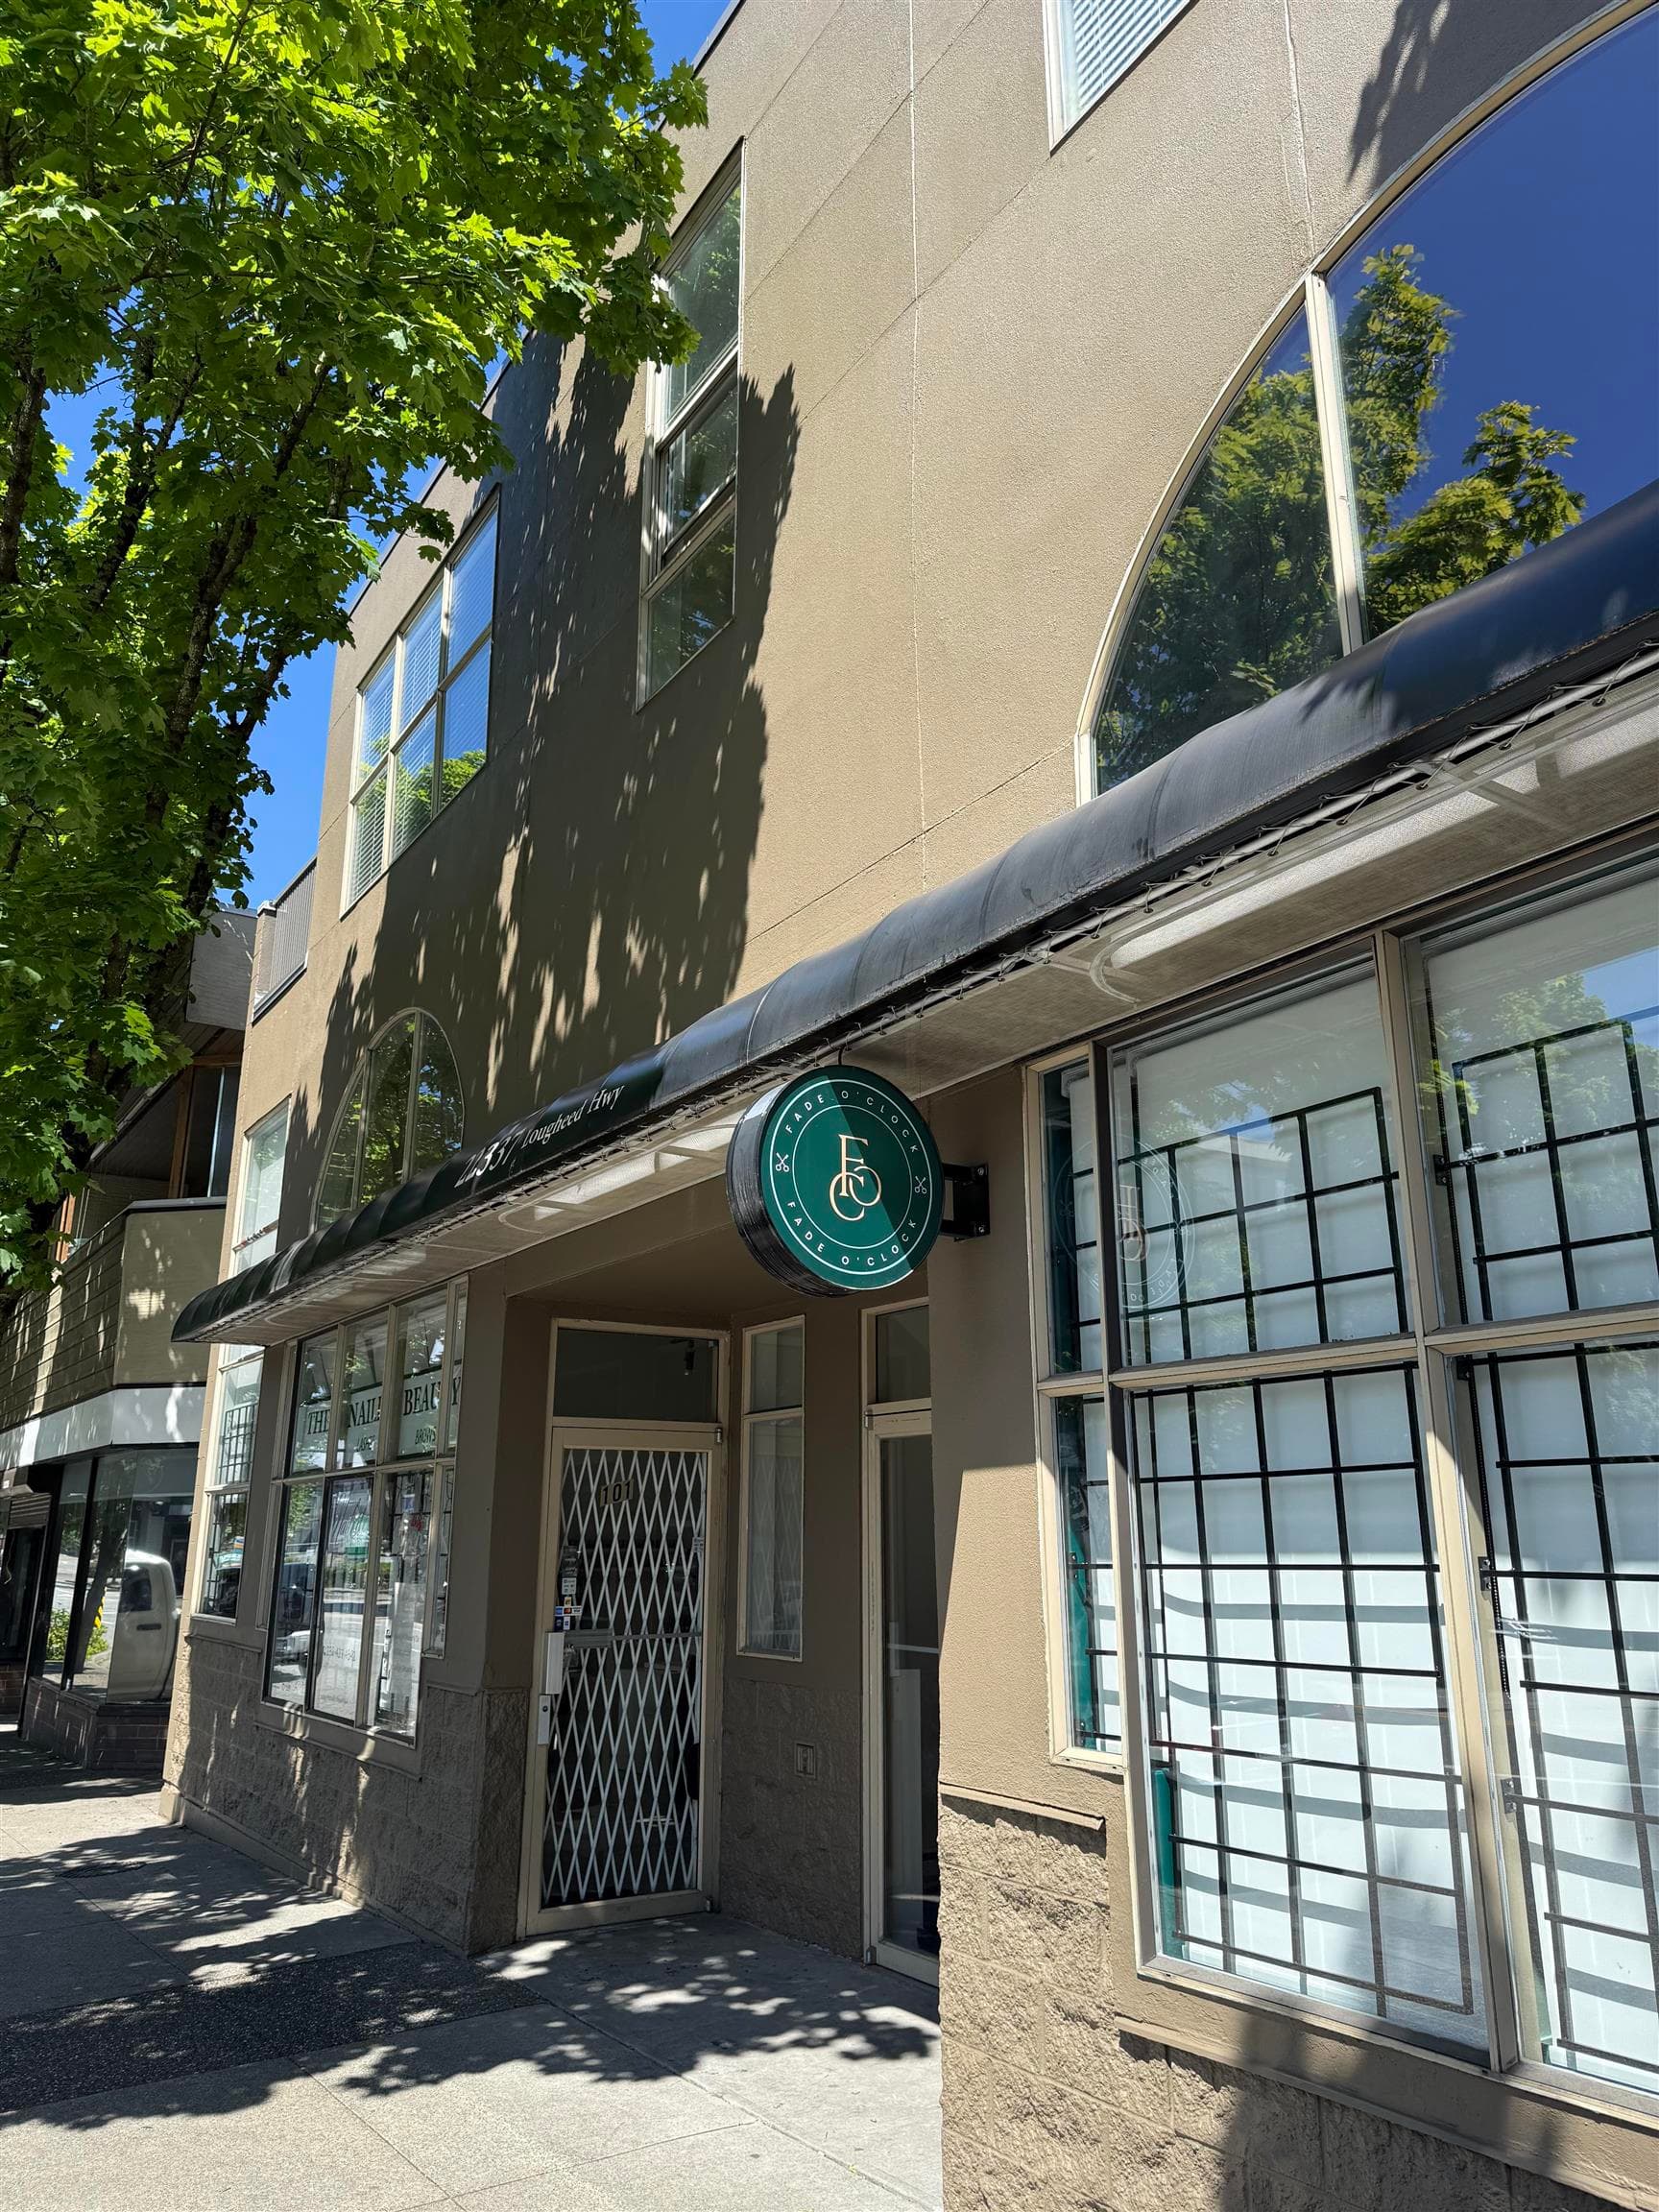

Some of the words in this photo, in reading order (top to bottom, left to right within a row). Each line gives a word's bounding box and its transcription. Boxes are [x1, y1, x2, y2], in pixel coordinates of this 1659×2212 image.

[521, 1100, 588, 1149] Lougheed
[587, 1085, 625, 1114] Hwy
[785, 1094, 825, 1134] FADE
[841, 1091, 918, 1153] O'CLOCK
[787, 1201, 825, 1253] FADE
[841, 1219, 917, 1266] O'CLOCK
[403, 1377, 461, 1416] BEAUY
[602, 1479, 631, 1505] 101
